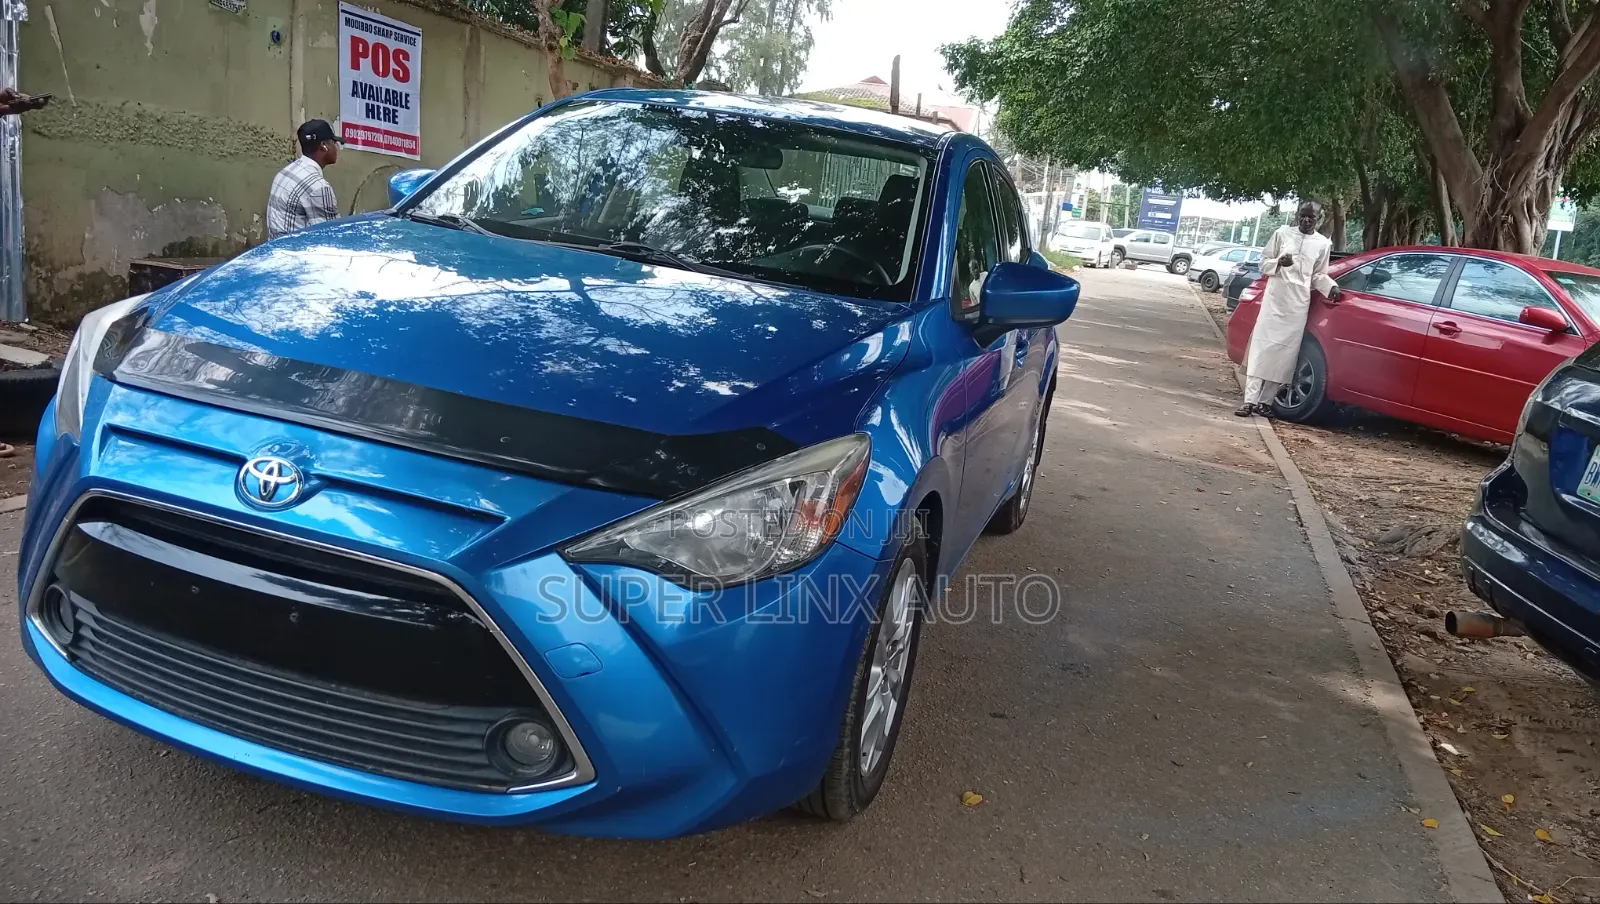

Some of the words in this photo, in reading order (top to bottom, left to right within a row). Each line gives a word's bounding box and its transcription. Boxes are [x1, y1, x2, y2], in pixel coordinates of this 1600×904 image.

[344, 16, 373, 34] MODIBBO
[373, 25, 393, 40] SHARP
[393, 31, 417, 47] SERVICE
[350, 34, 411, 84] POS
[351, 80, 410, 110] AVAILABLE
[365, 102, 399, 125] HERE
